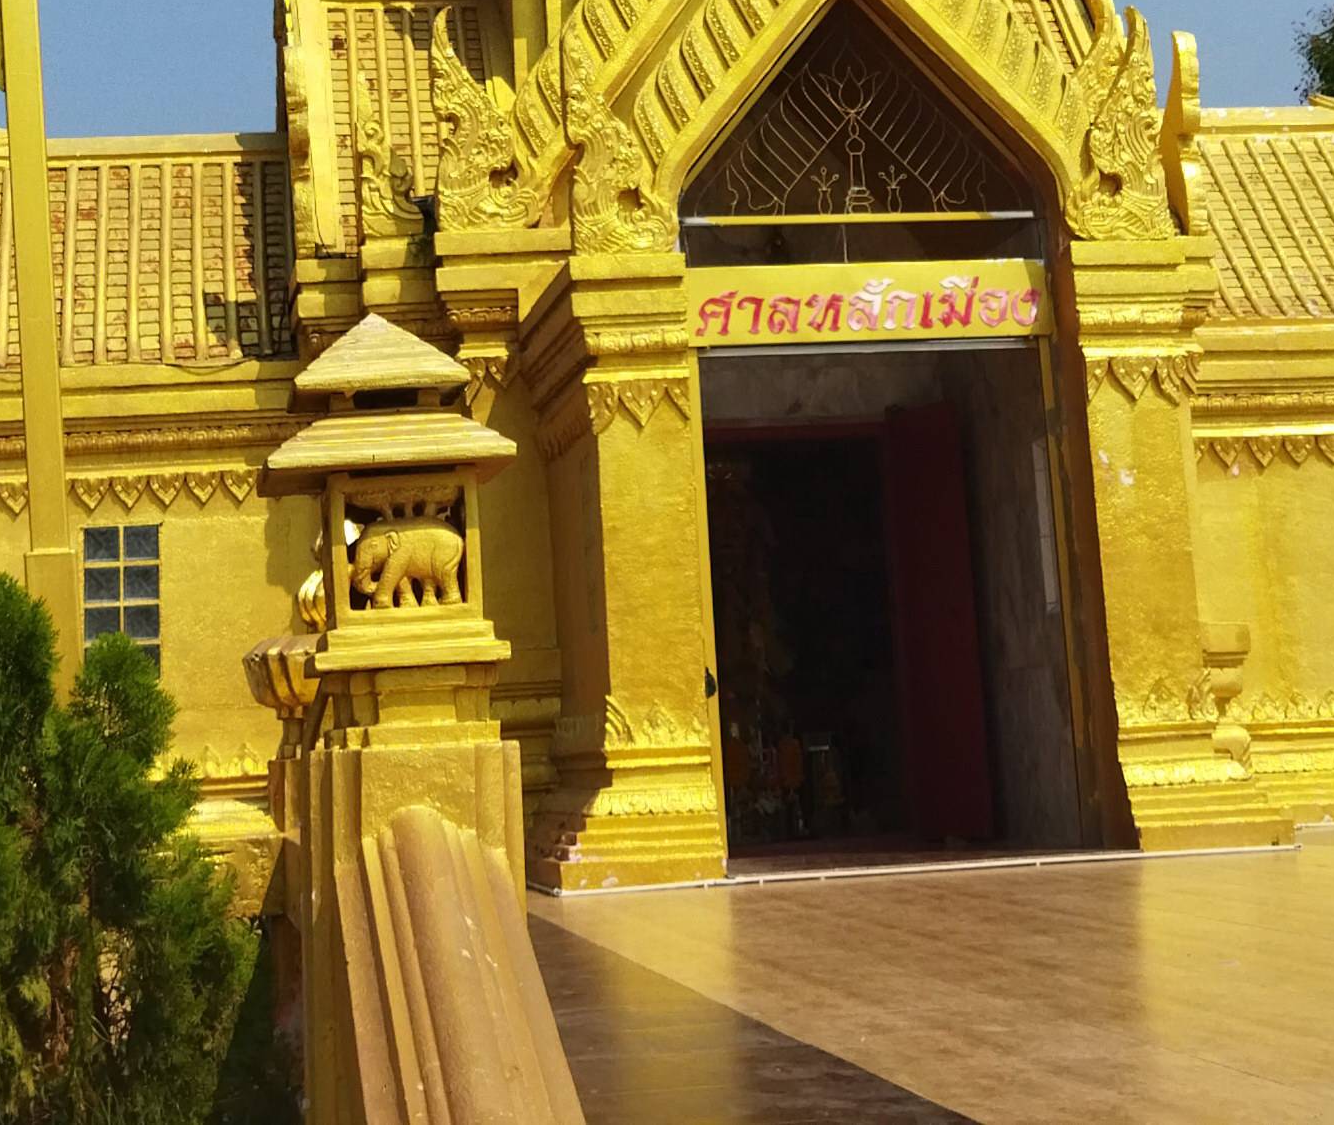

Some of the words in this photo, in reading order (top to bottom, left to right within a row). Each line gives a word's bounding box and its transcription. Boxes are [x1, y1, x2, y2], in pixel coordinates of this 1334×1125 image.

[695, 276, 1042, 337] ศาลหลักเมือง
